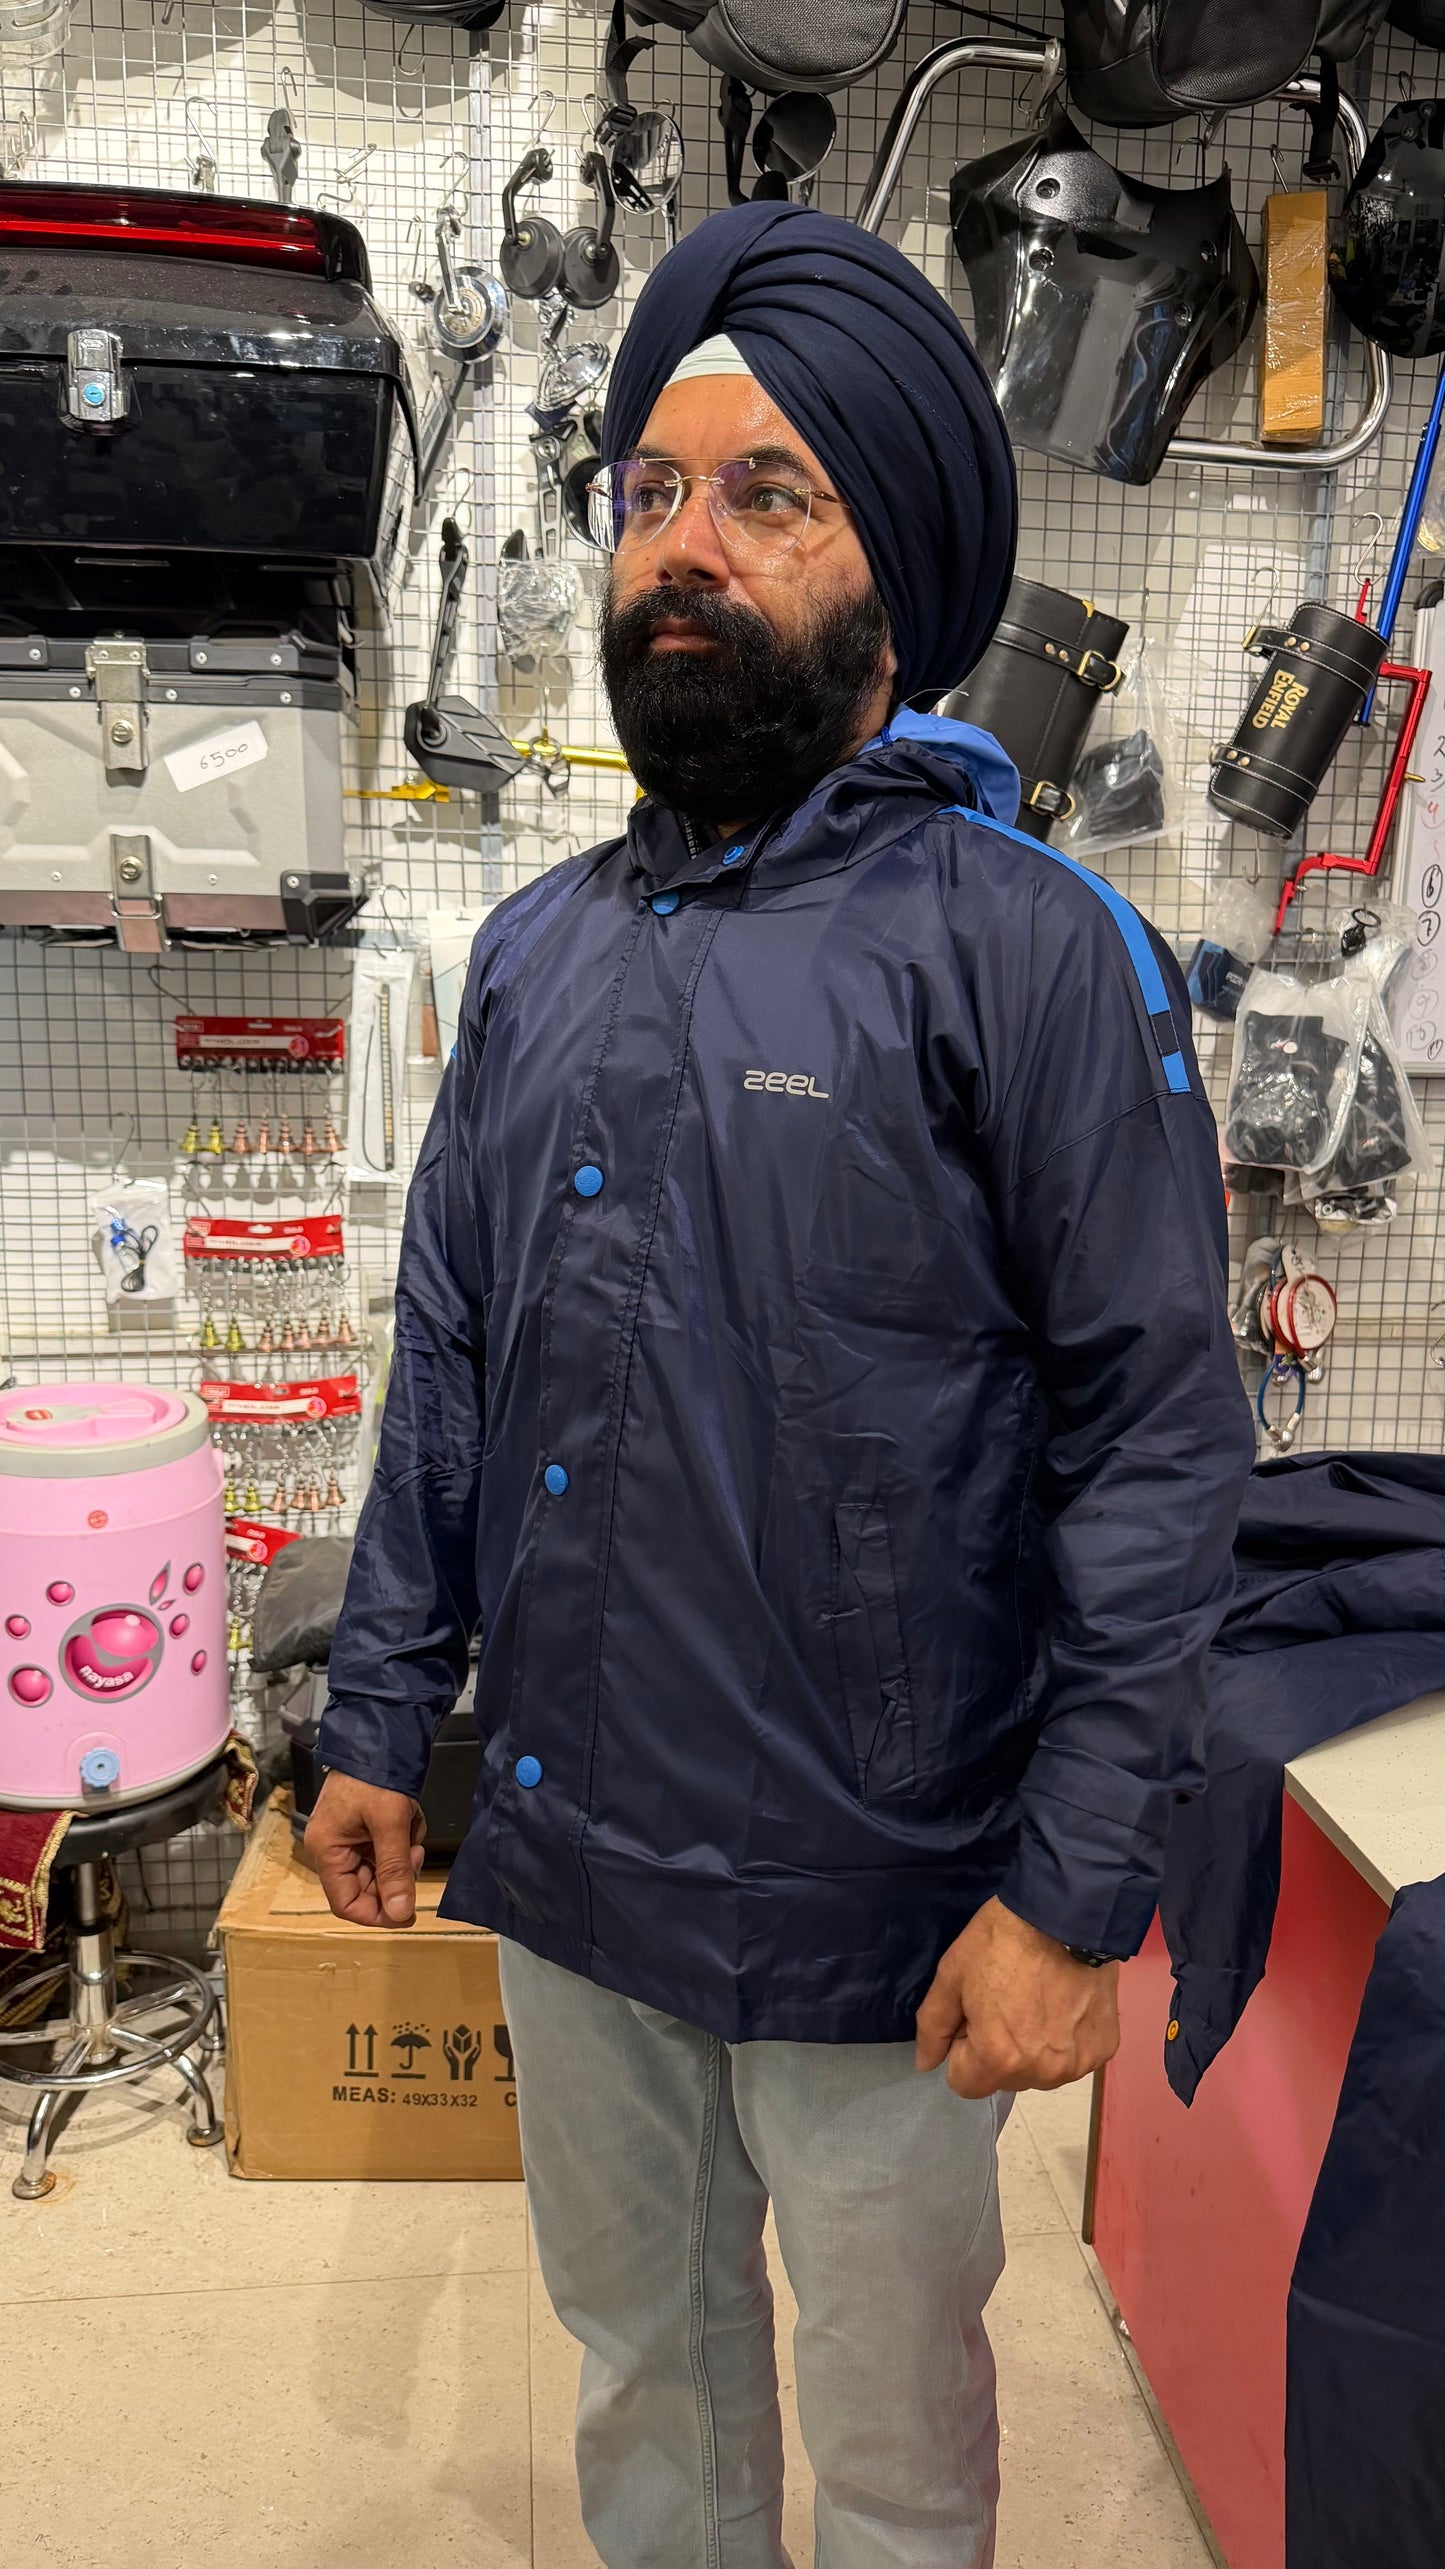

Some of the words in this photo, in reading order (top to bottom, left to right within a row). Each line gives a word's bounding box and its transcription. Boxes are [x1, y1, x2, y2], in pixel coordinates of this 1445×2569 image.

[1252, 669, 1296, 729] ENFIELD
[1269, 682, 1309, 729] ROYAL
[200, 743, 248, 770] 6500
[79, 1665, 134, 1689] nayasa
[332, 2086, 396, 2104] MEAS:
